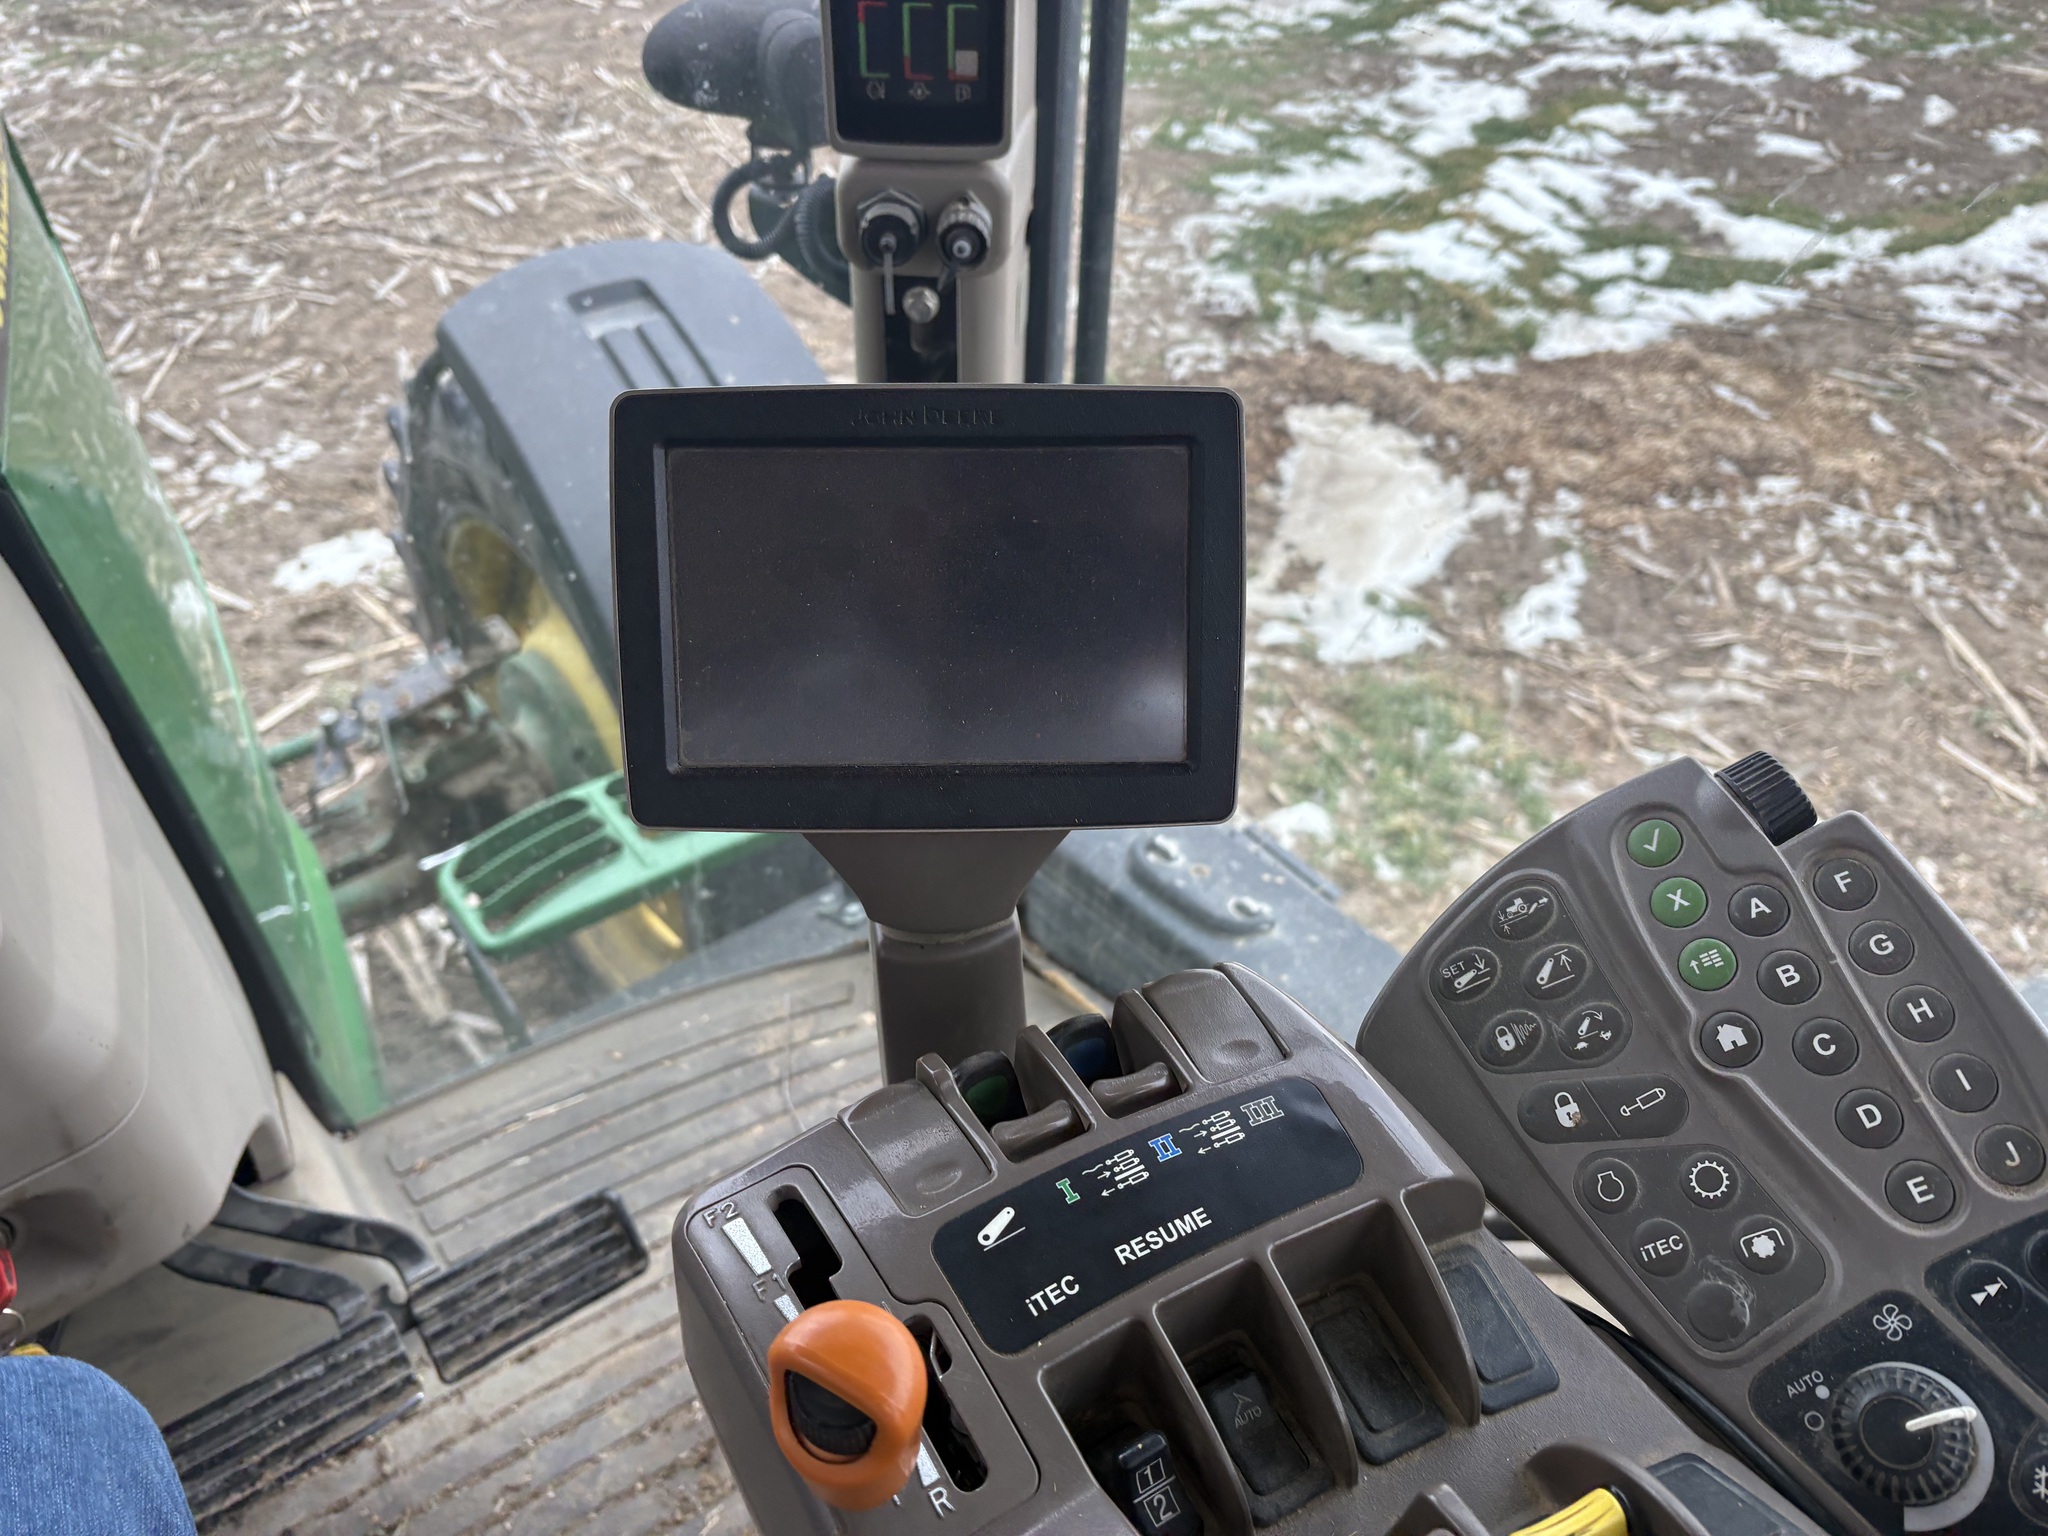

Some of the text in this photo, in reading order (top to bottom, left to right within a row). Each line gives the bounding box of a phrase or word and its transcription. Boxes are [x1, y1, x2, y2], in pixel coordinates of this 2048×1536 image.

[1834, 870, 1855, 894] F
[1748, 896, 1772, 920] A
[1869, 933, 1895, 956] G
[1442, 960, 1465, 979] SET
[1775, 964, 1800, 988] B
[1906, 997, 1935, 1025] H
[1812, 1033, 1836, 1057] C
[1956, 1068, 1972, 1091] I
[1855, 1103, 1882, 1129] D
[2004, 1140, 2022, 1169] J
[1905, 1175, 1935, 1204] E
[703, 1202, 739, 1228] F2
[1114, 1207, 1212, 1265] RESUME
[1640, 1235, 1683, 1262] iTEC
[753, 1273, 786, 1302] F1
[1025, 1275, 1080, 1317] iTEC
[1786, 1370, 1824, 1398] AUTO
[1234, 1406, 1262, 1429] AUTO
[1143, 1464, 1154, 1485] 1
[927, 1486, 956, 1519] R
[1153, 1494, 1174, 1521] 2
